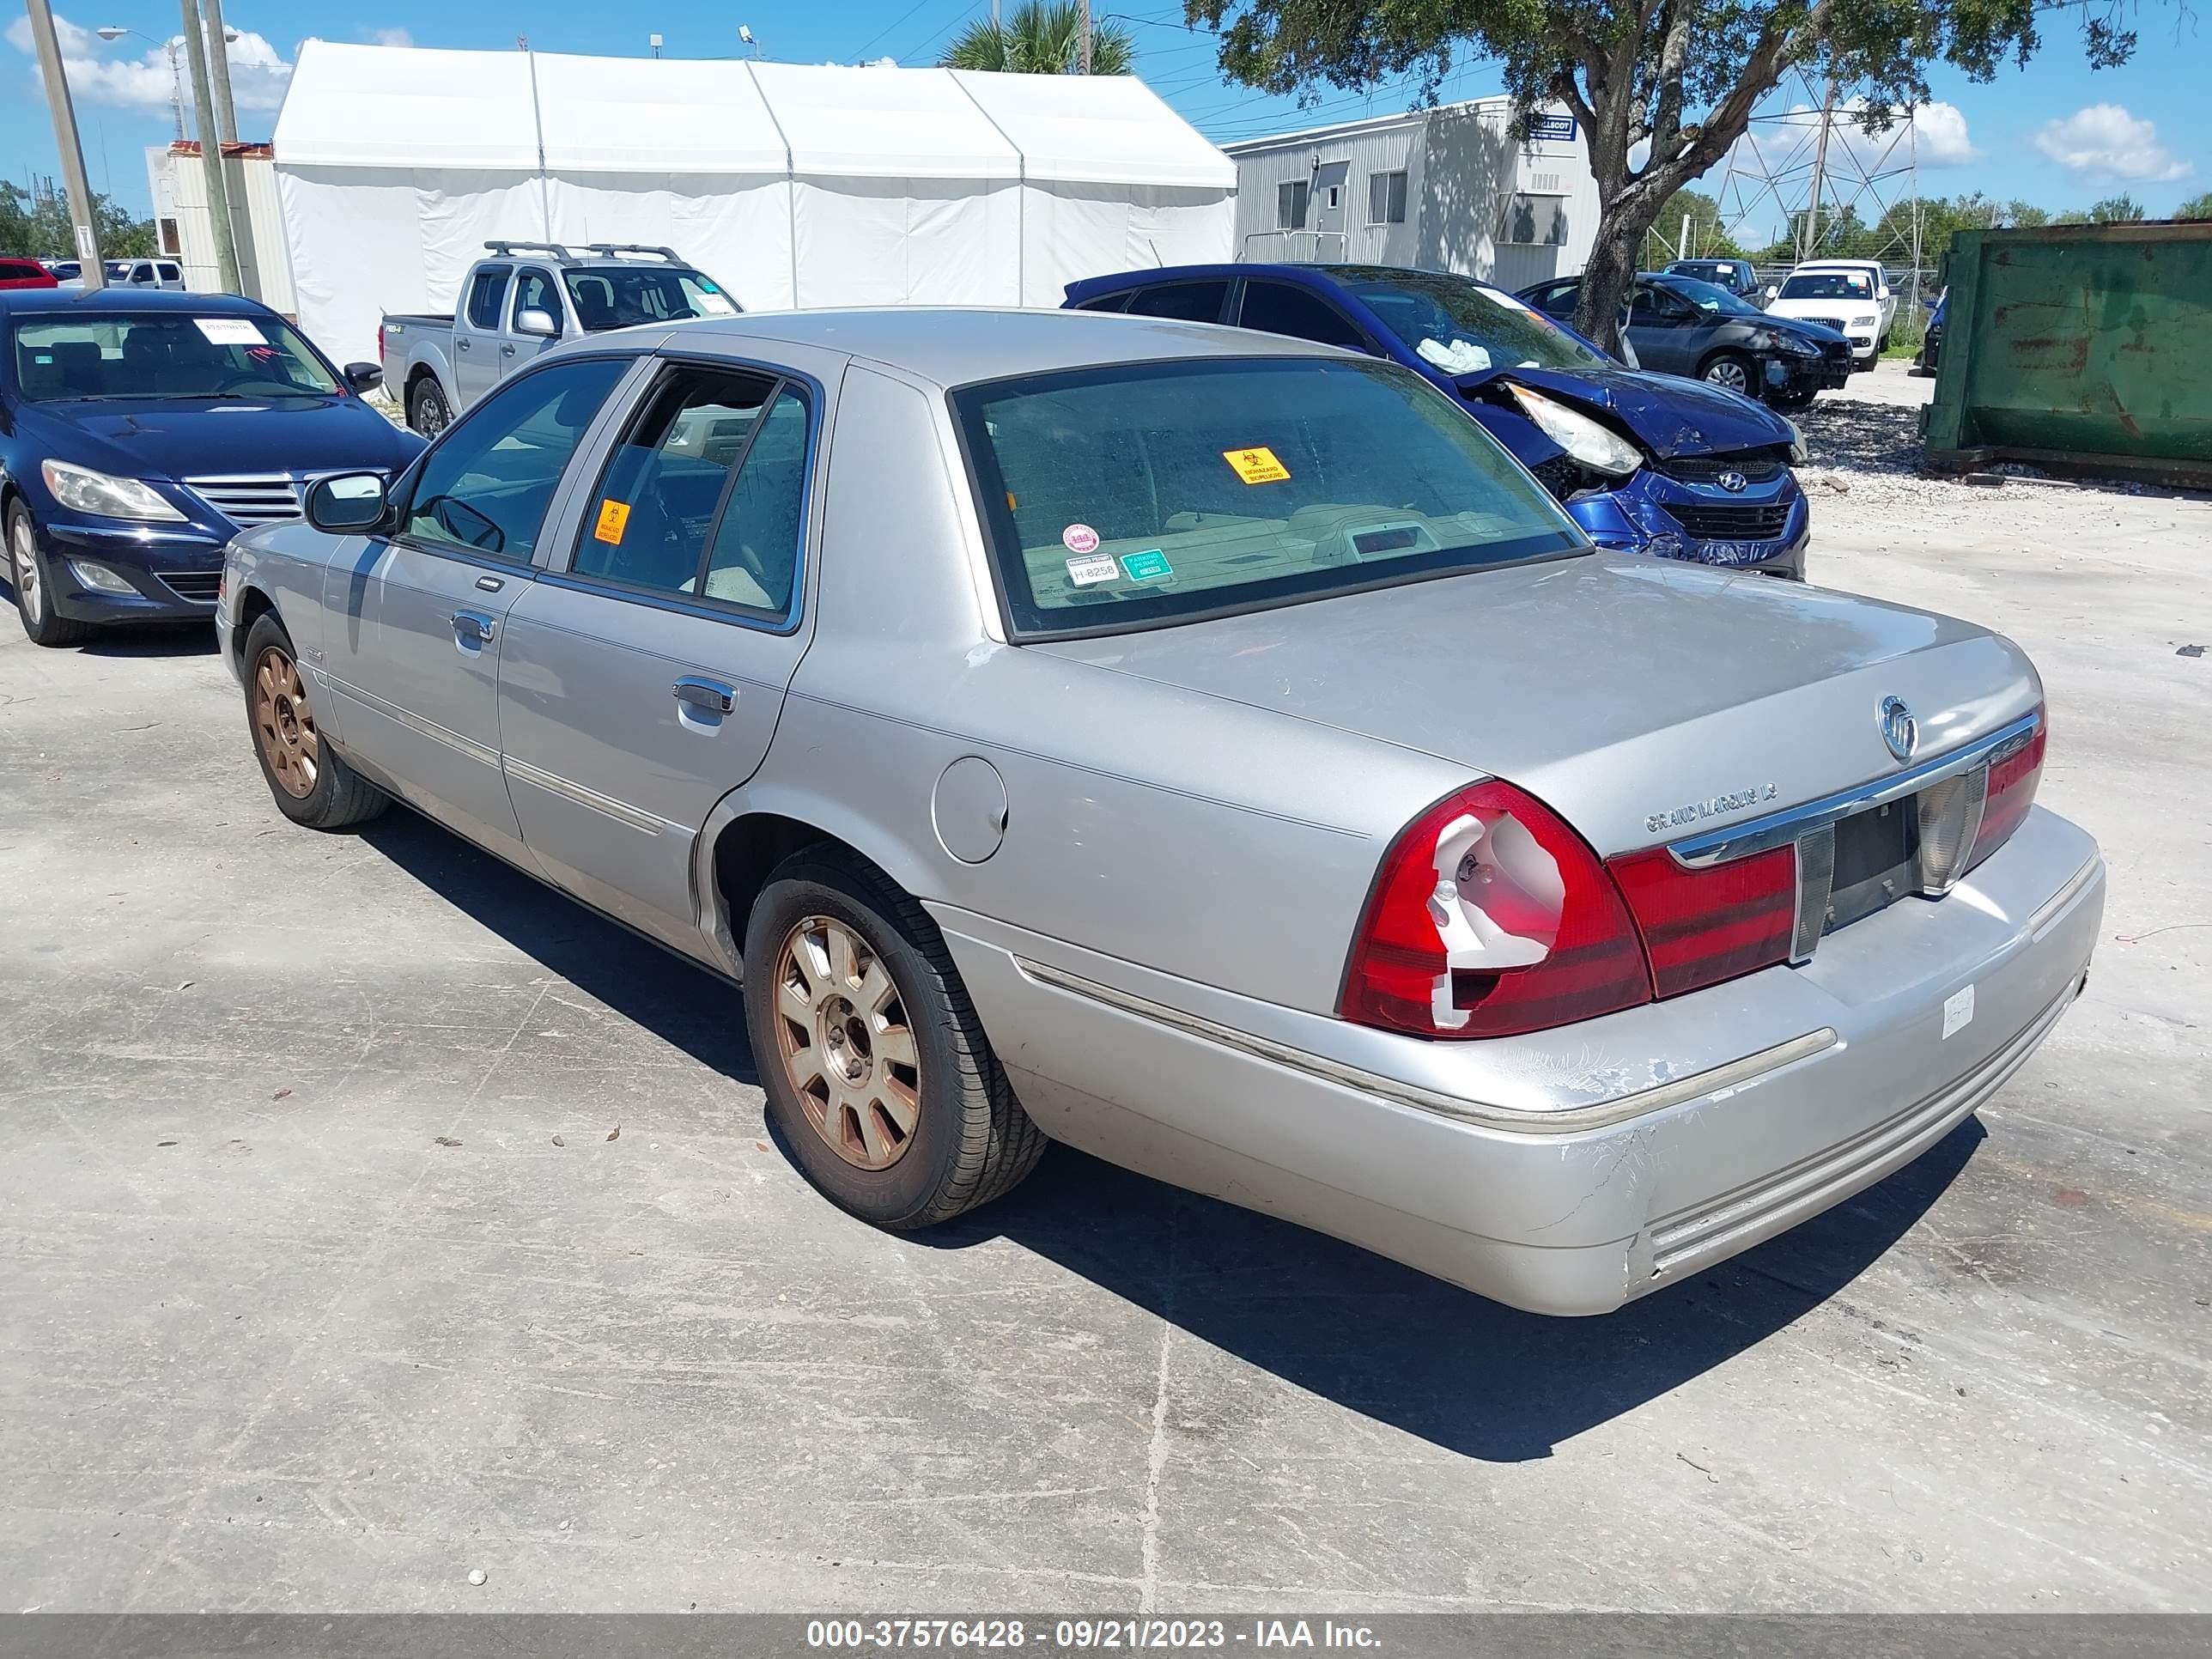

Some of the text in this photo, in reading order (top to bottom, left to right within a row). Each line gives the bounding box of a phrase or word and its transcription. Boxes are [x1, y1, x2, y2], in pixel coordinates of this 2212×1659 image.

[1244, 466, 1279, 476] BIOHAZARD
[1069, 558, 1091, 567] PARKING
[1128, 554, 1159, 564] PARKING
[1134, 559, 1159, 569] PERMIT
[1074, 566, 1115, 580] H-8258
[1644, 782, 1778, 833] GRAND MARQUIS LS
